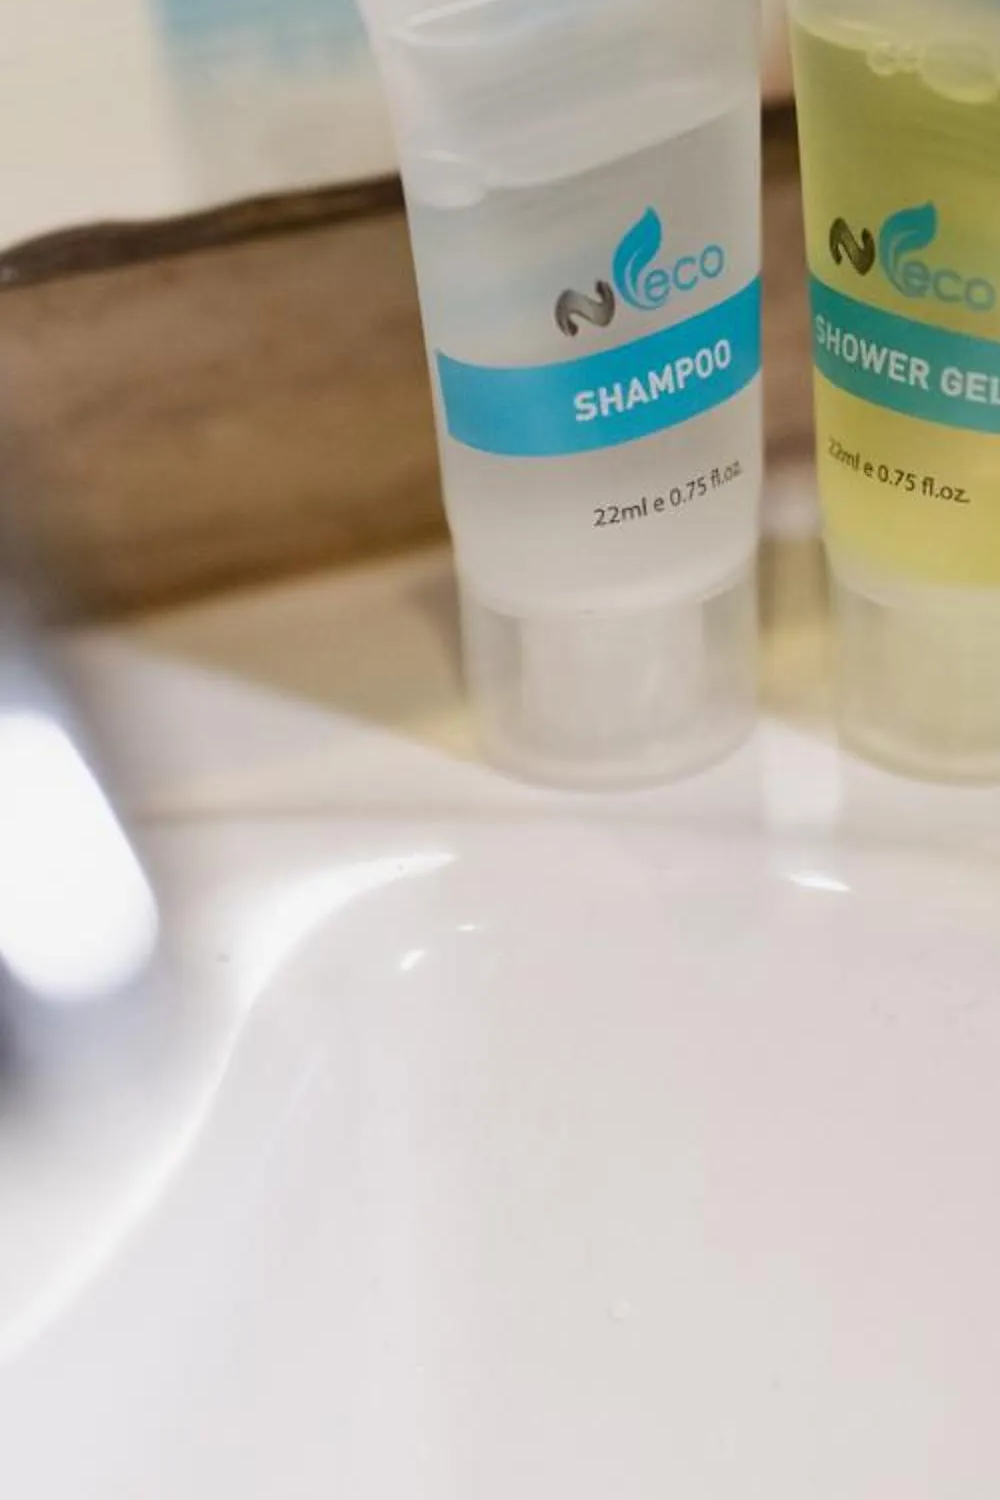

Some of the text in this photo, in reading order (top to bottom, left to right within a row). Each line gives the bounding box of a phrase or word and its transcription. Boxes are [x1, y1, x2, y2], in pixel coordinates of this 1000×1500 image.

[574, 338, 733, 423] SHAMPOO
[814, 314, 930, 391] SHOWER
[594, 496, 648, 527] 22ml
[669, 476, 708, 507] 0.75
[877, 463, 917, 492] 0.75
